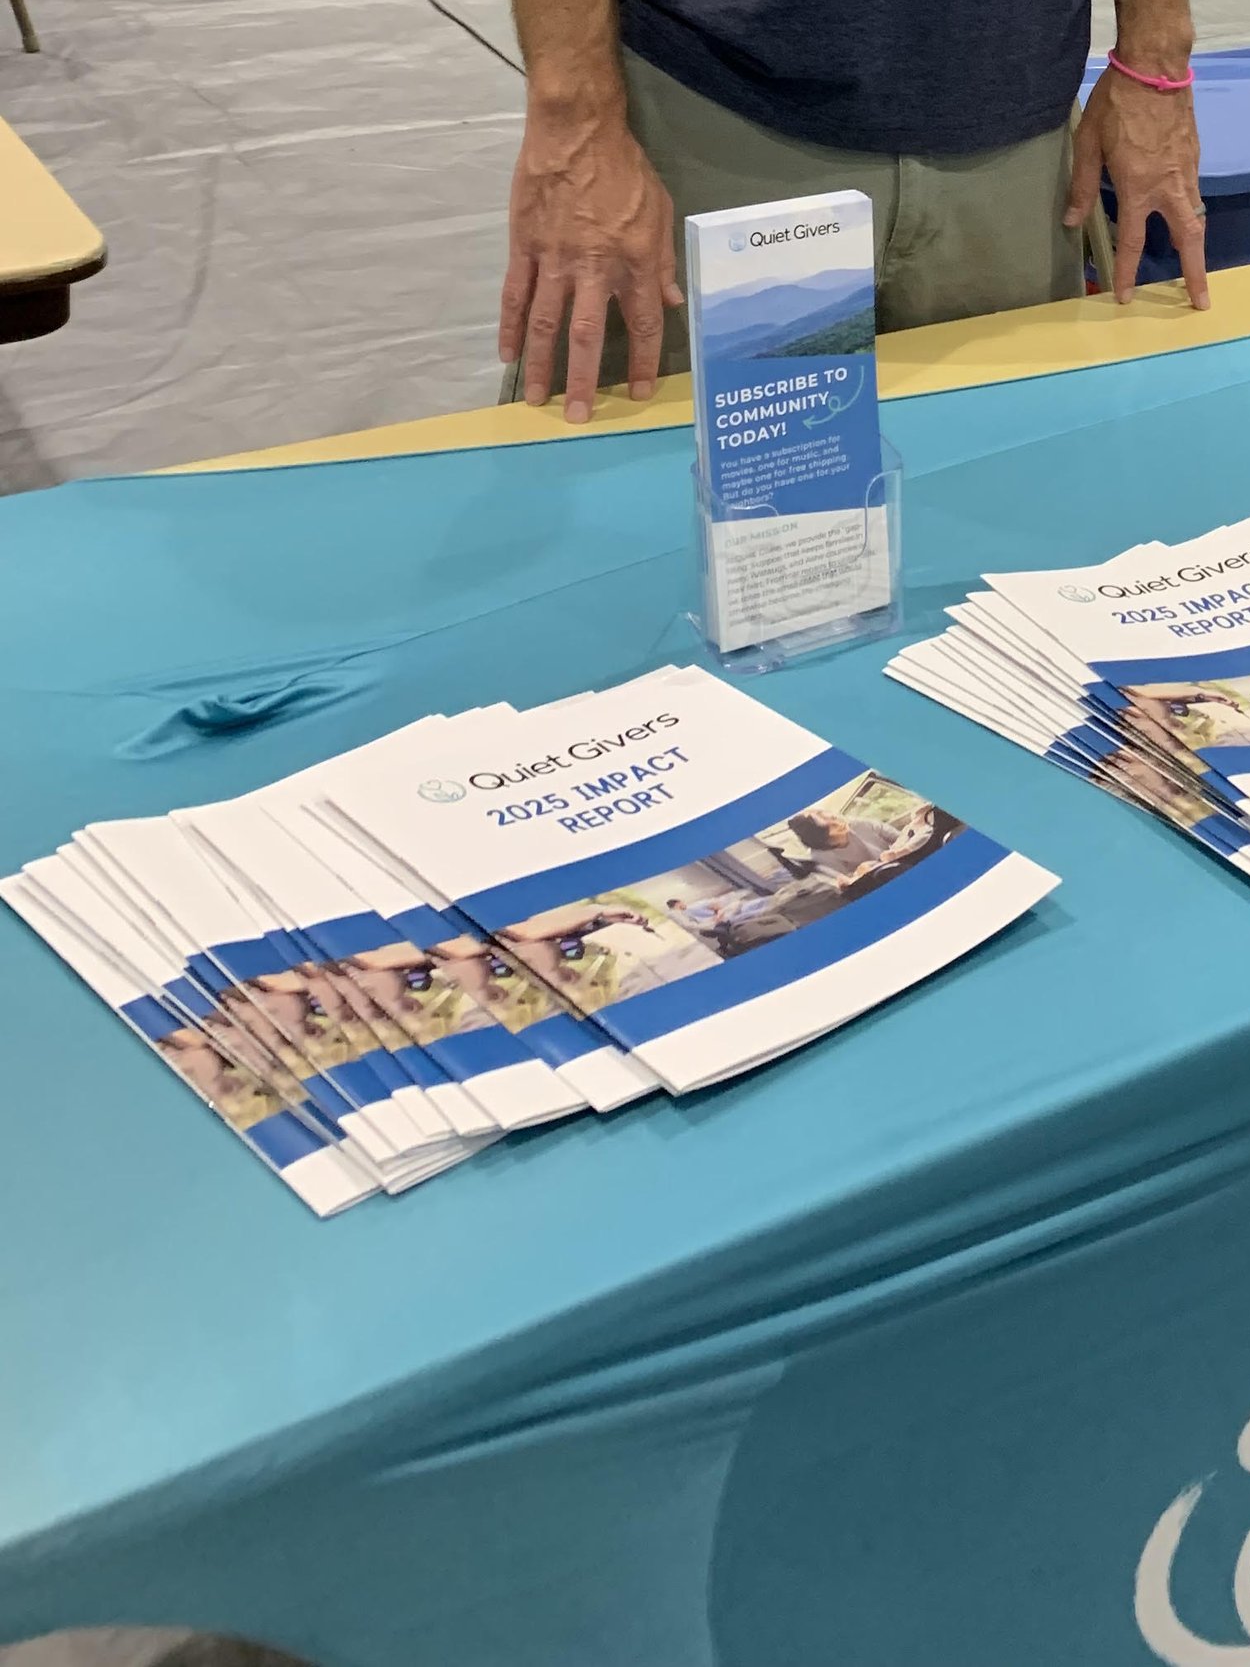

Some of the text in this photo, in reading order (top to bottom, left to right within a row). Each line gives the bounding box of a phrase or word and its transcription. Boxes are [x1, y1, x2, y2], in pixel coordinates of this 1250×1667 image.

[749, 220, 840, 248] Quiet Givers
[715, 367, 848, 408] SUBSCRIBE TO
[716, 391, 829, 429] COMMUNITY
[717, 422, 787, 450] TODAY!
[720, 460, 738, 469] You
[740, 453, 762, 464] have
[771, 436, 826, 457] subscription
[828, 435, 841, 444] for
[722, 478, 753, 491] maybe
[755, 472, 772, 482] one
[773, 468, 786, 477] for
[808, 453, 847, 470] shipping
[757, 462, 775, 471] one
[777, 457, 789, 466] for
[822, 445, 840, 455] and
[774, 477, 796, 488] have
[1098, 574, 1180, 600] Quiet
[1111, 605, 1177, 624] 2025
[469, 711, 680, 793] Quiet Givers
[486, 745, 690, 826] 2025 IMPACT
[556, 783, 675, 834] REPORT
